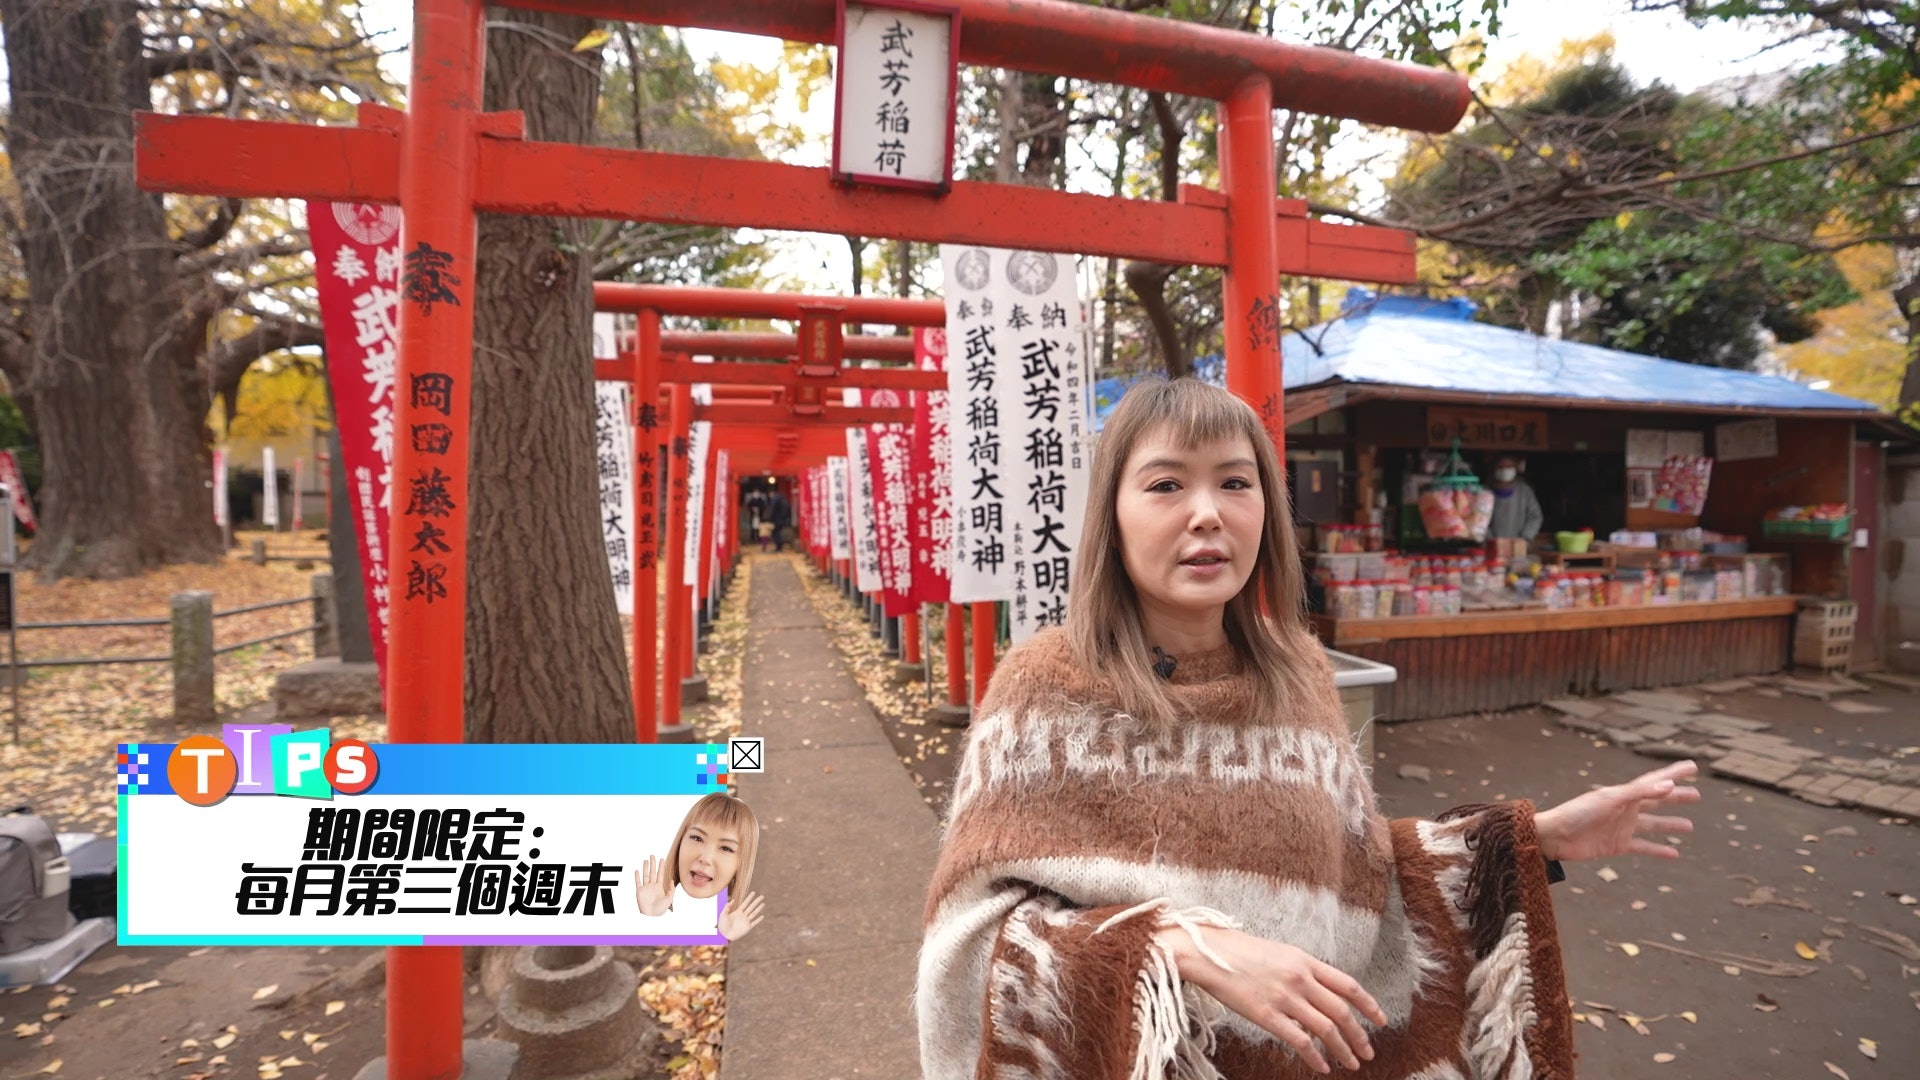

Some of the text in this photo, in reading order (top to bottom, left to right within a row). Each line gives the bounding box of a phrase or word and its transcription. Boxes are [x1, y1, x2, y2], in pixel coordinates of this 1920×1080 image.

[874, 19, 914, 176] 武芳稲荷
[1008, 302, 1067, 331] 奉納
[965, 324, 1005, 577] 武芳稲荷大明神
[1064, 341, 1082, 470] 令和四年二月吉日
[405, 372, 457, 603] 岡田藤太郎
